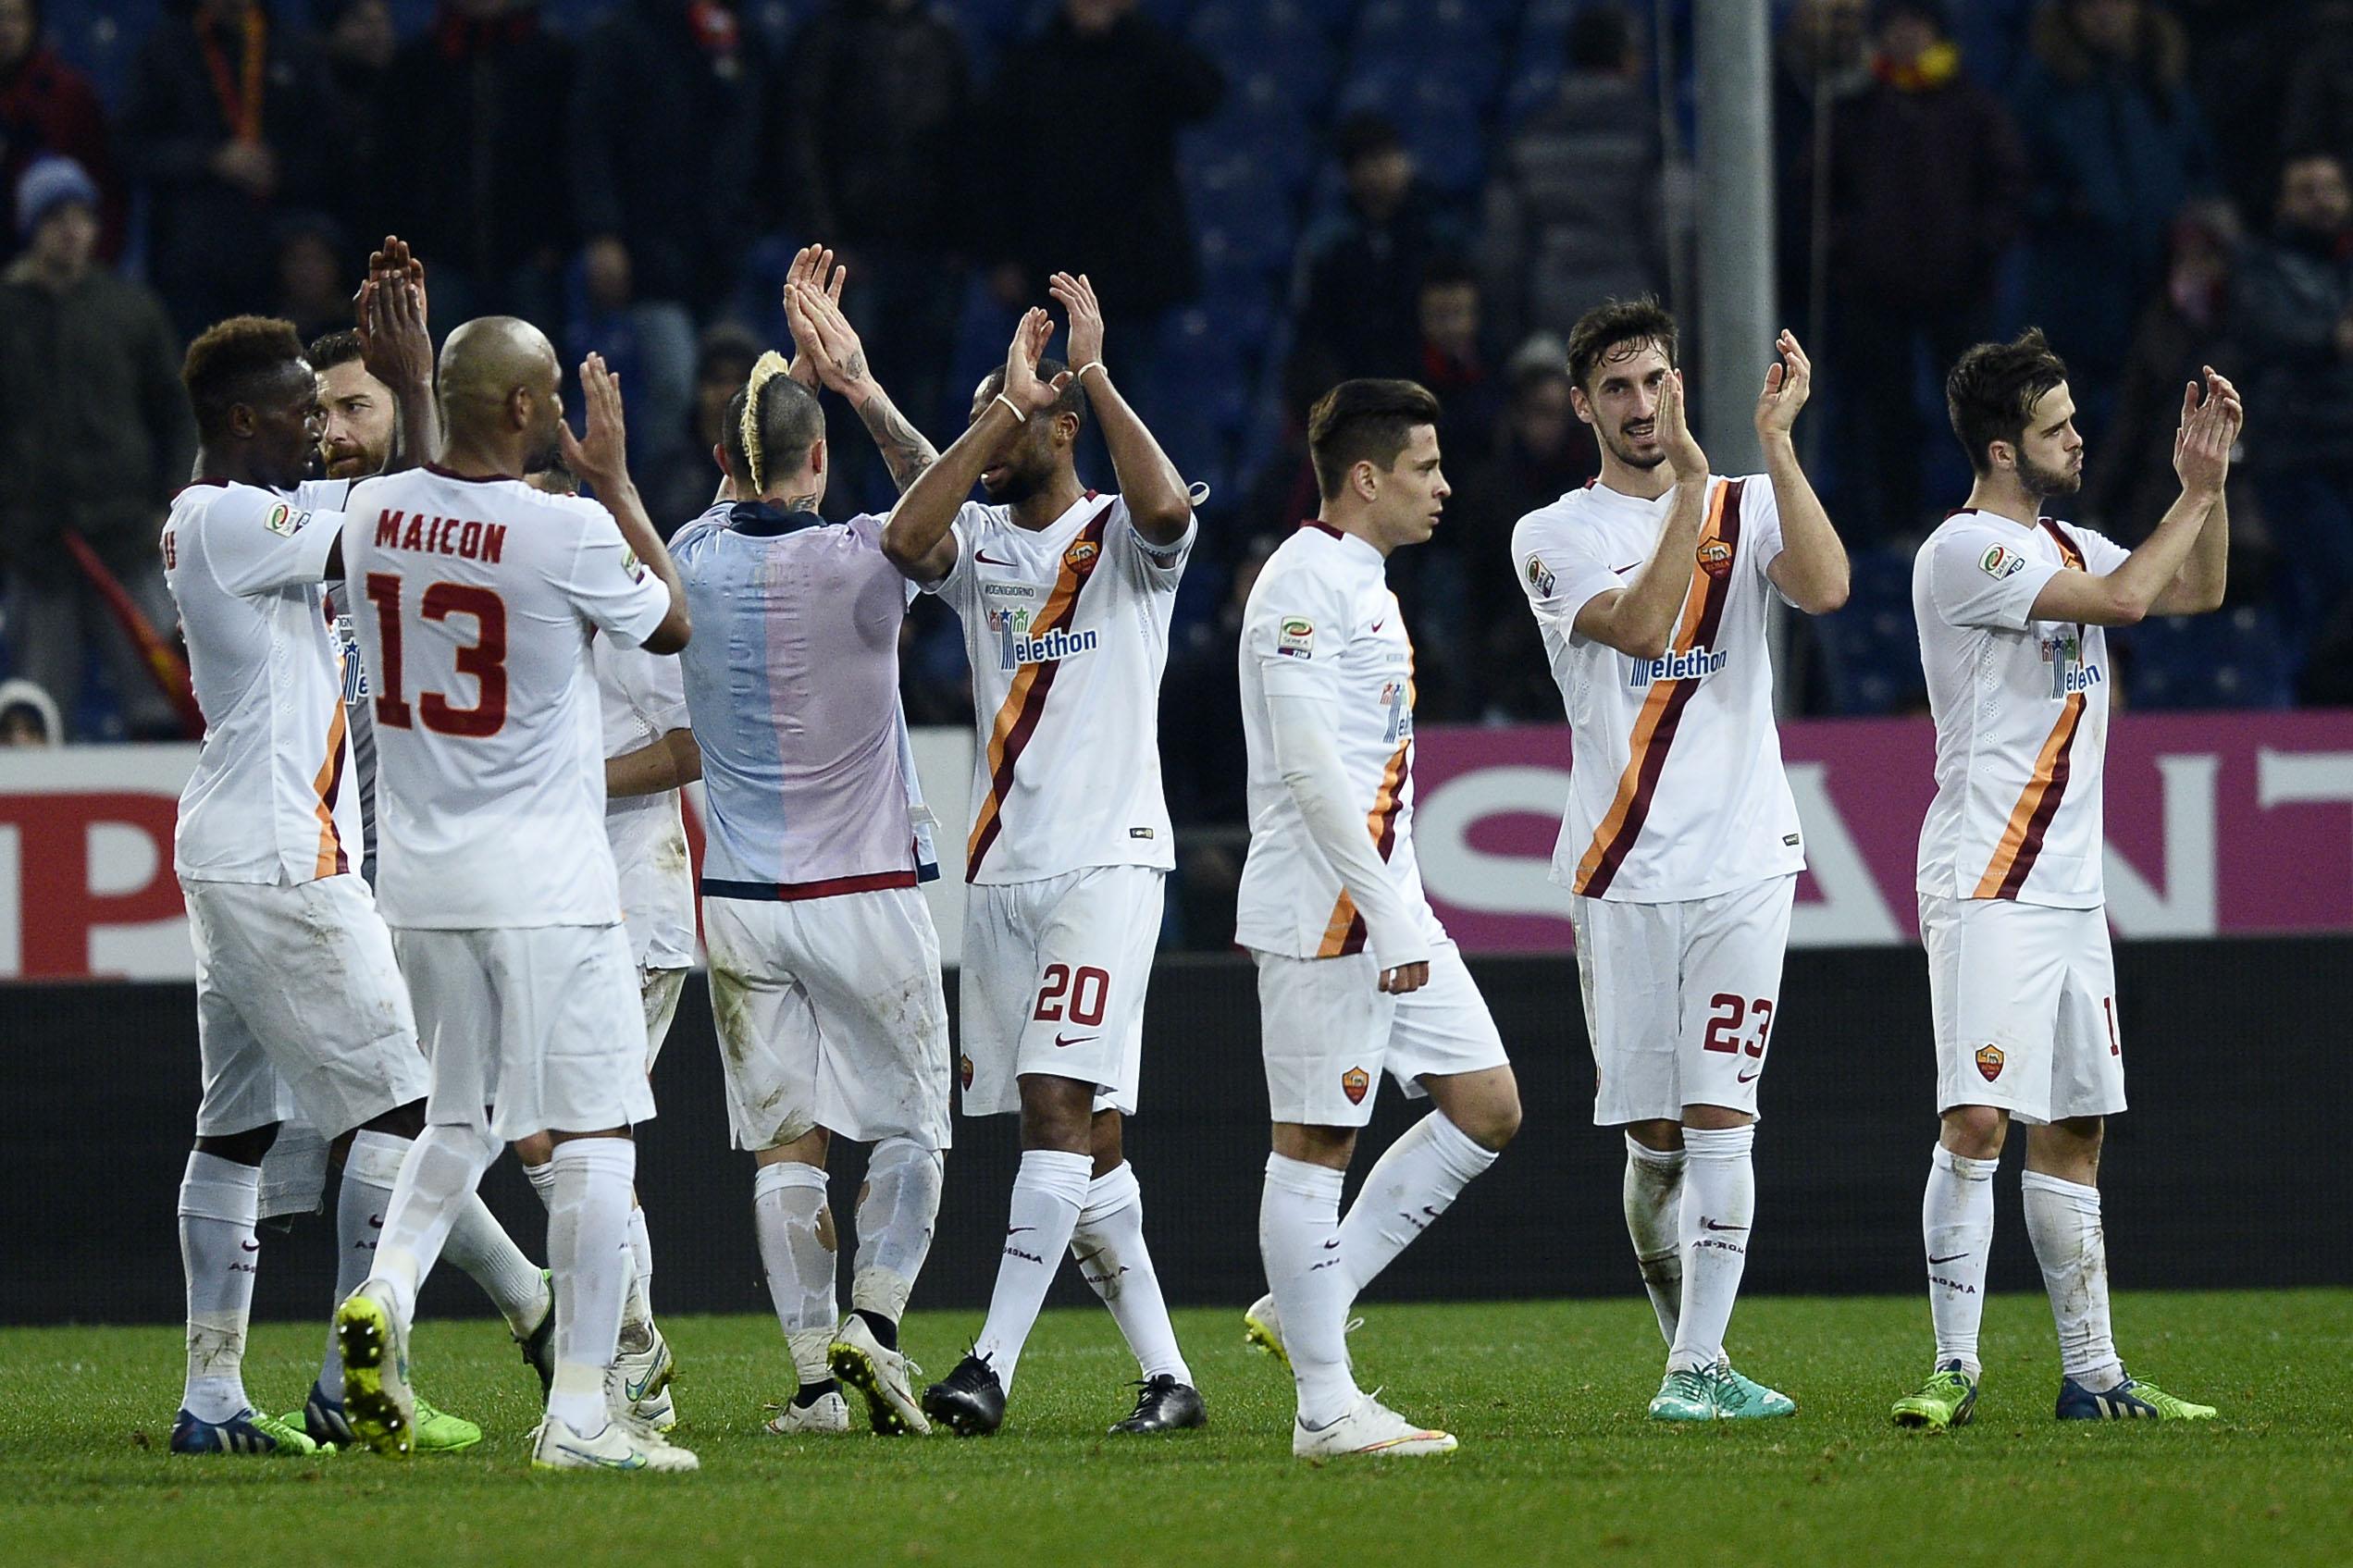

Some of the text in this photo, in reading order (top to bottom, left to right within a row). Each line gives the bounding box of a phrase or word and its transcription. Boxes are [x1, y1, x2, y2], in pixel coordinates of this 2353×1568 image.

[375, 509, 507, 564] MAICON
[365, 572, 508, 738] 13
[1000, 607, 1097, 671] Telethon
[1033, 963, 1110, 1027] 20
[1703, 993, 1773, 1059] 23
